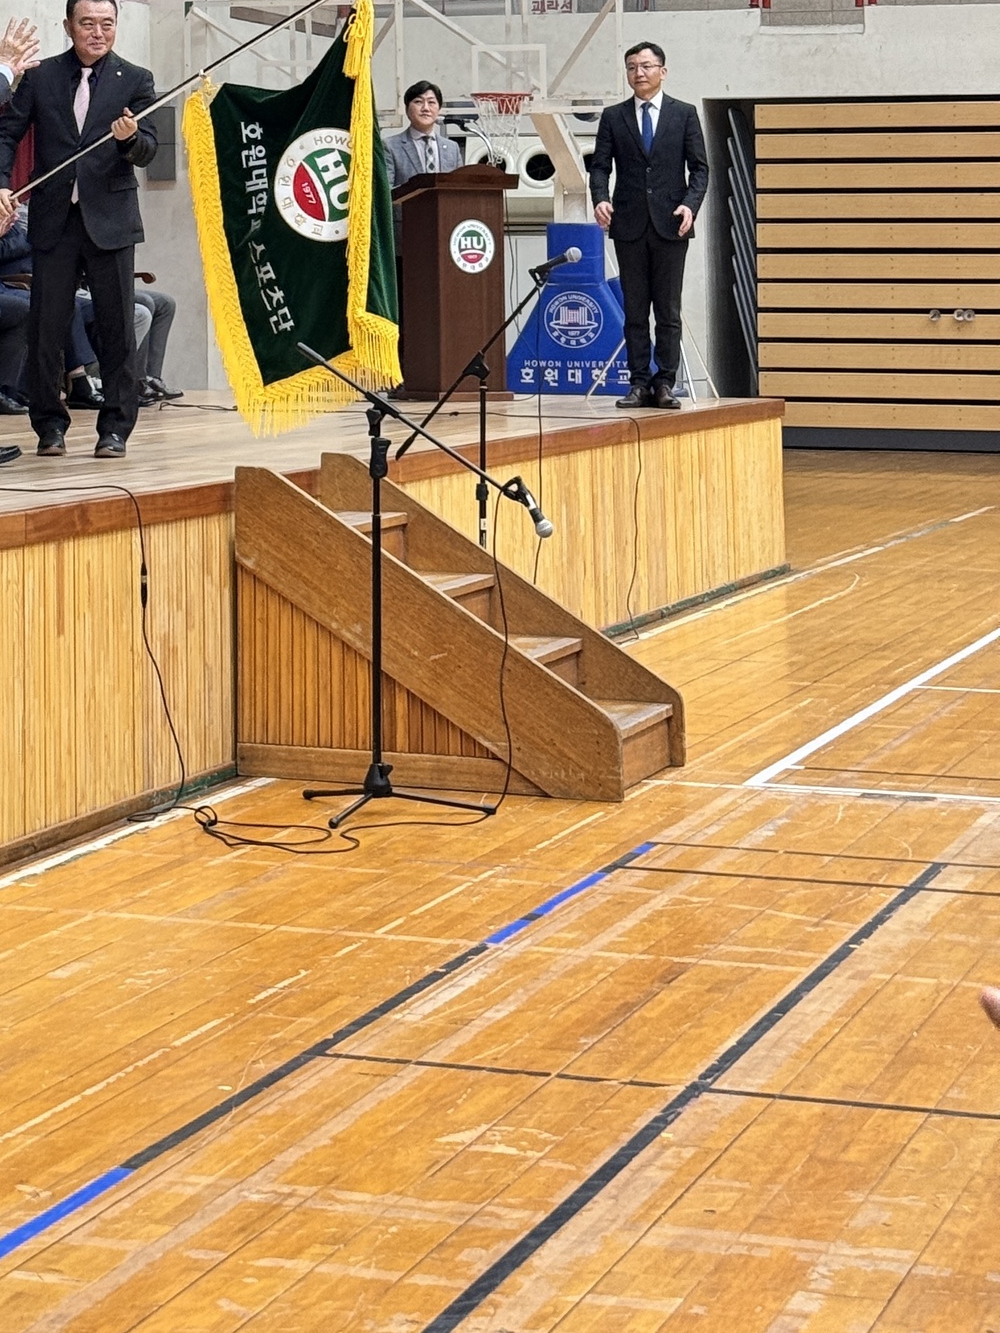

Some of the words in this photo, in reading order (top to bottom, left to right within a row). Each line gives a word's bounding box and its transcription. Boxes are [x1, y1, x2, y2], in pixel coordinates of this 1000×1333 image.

[301, 182, 317, 205] 1977
[460, 236, 484, 250] HU
[248, 240, 295, 335] 스포츠단
[524, 359, 562, 368] HOWON
[520, 367, 631, 387] 호원대학교
